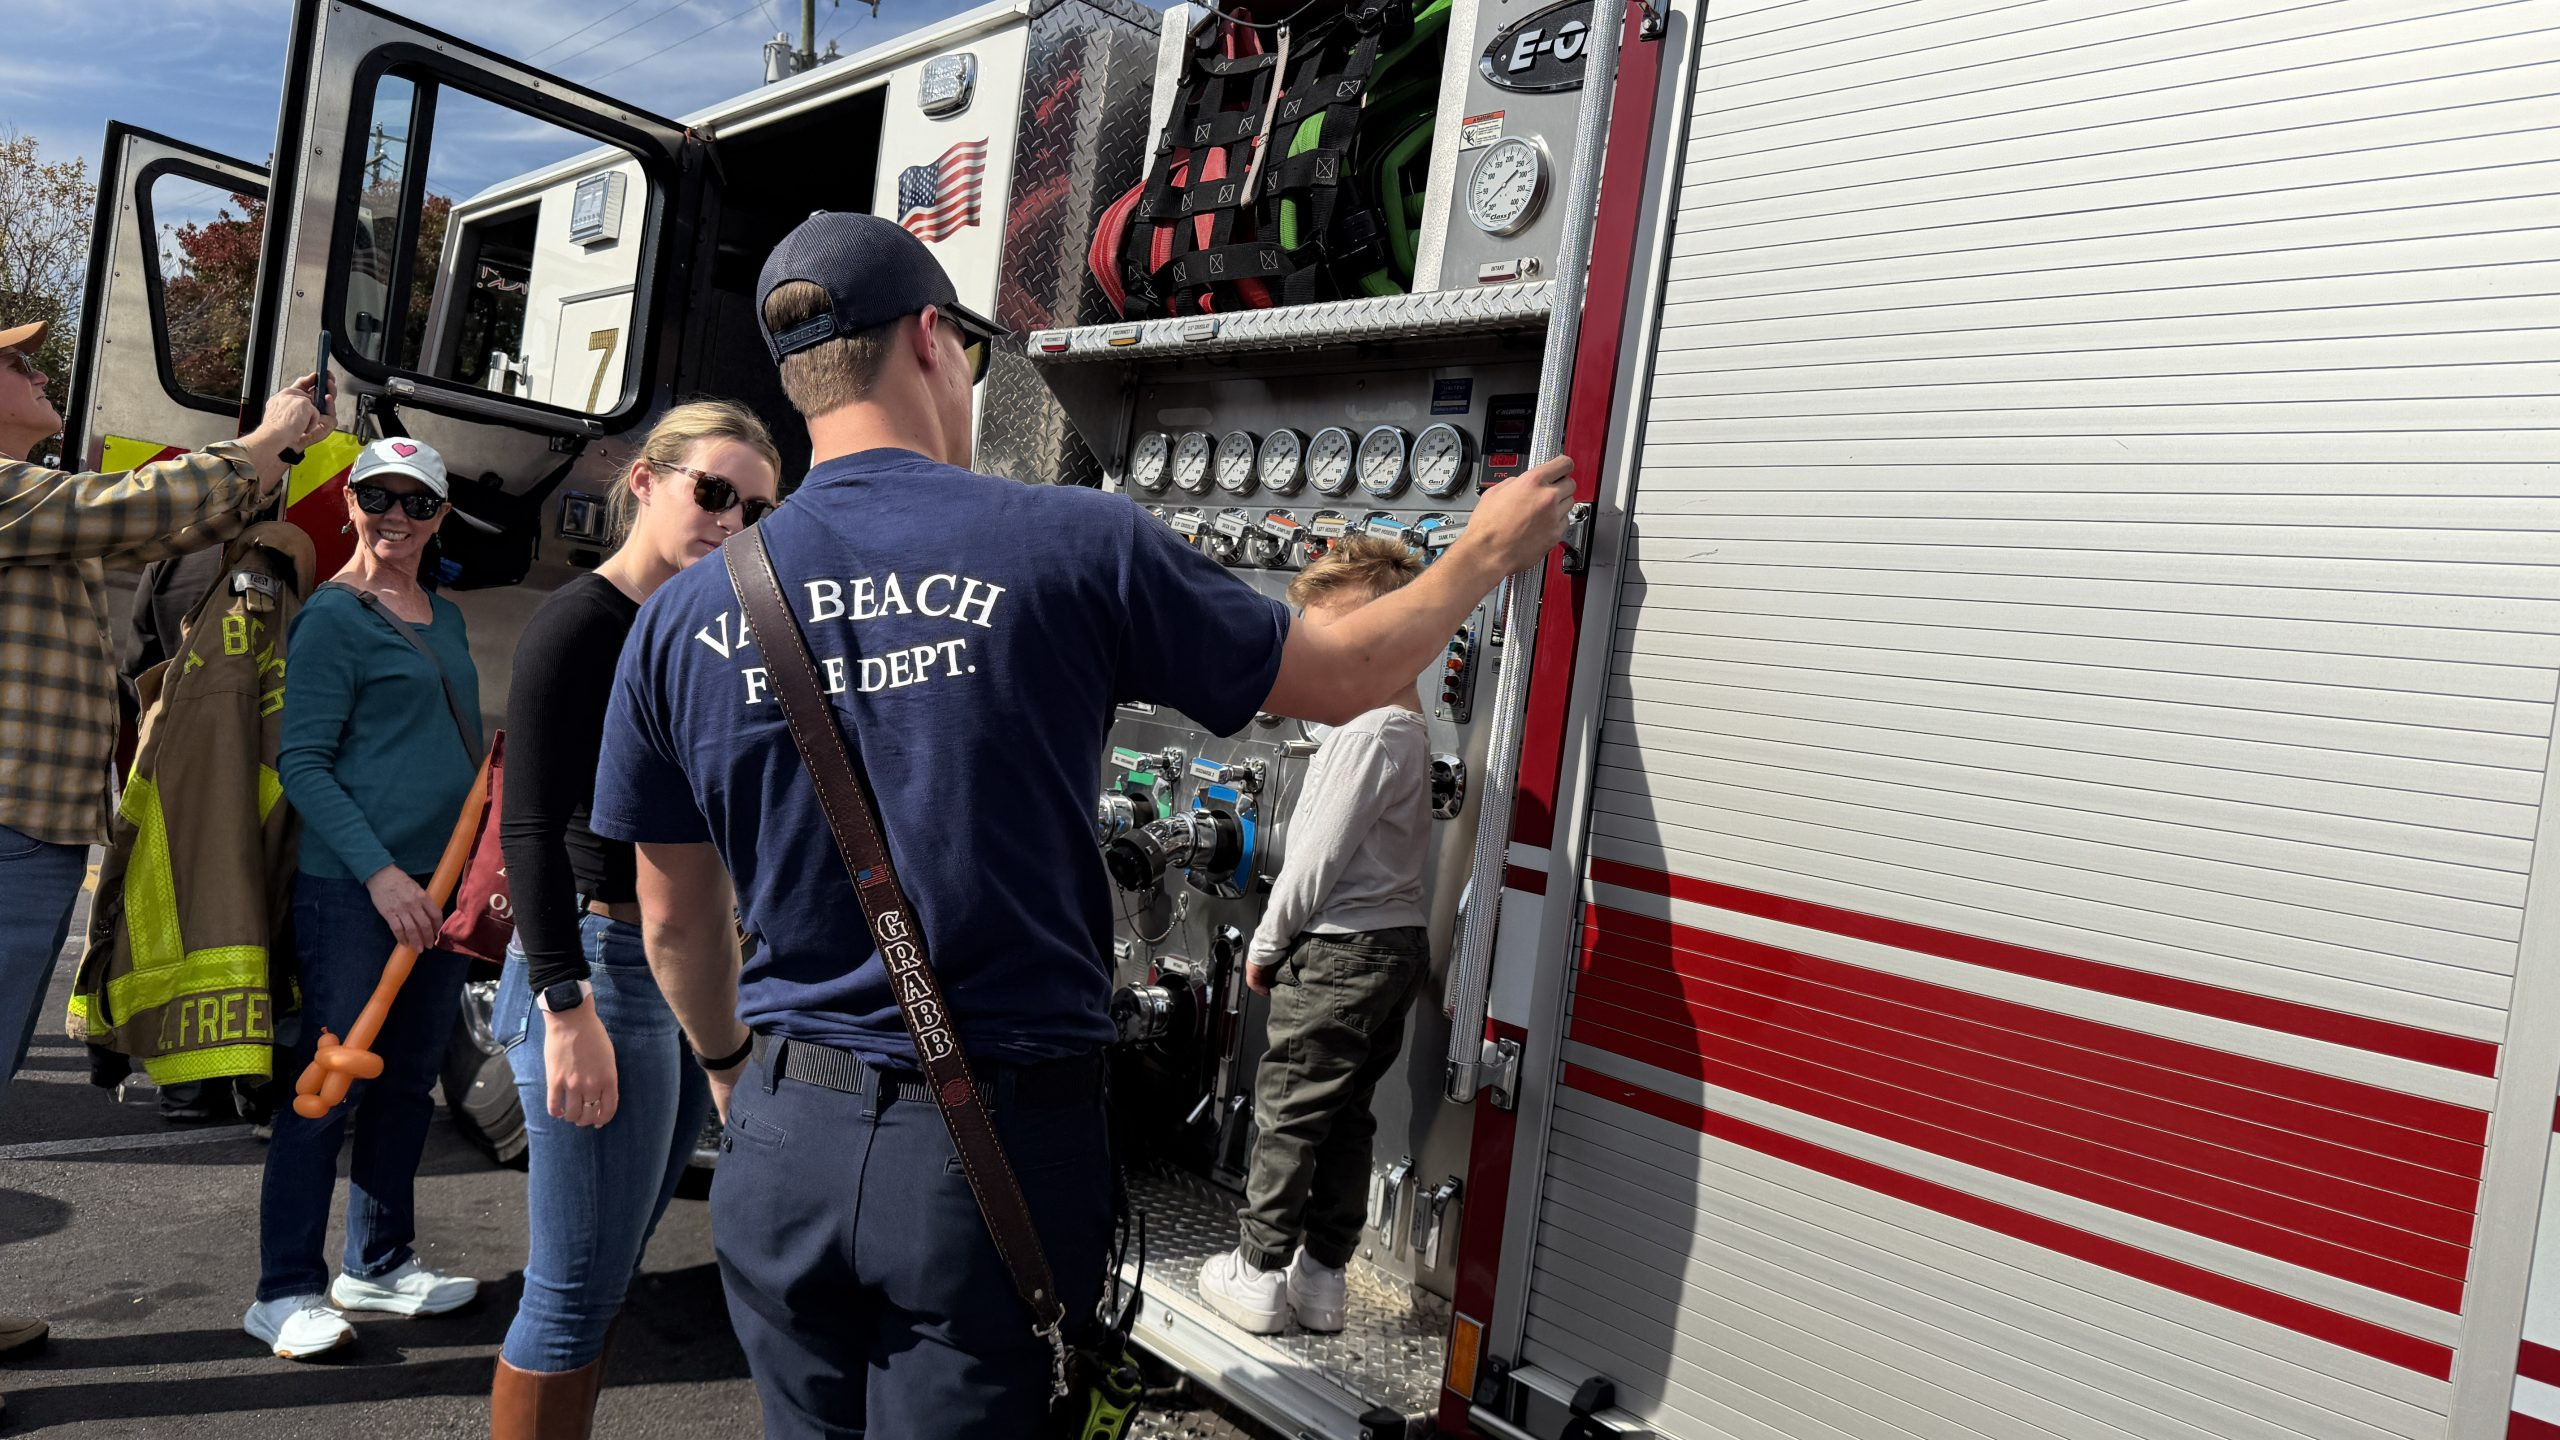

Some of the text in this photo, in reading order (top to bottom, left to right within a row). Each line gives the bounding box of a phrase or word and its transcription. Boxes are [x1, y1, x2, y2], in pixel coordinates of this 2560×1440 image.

[1508, 20, 1592, 71] E-O
[1505, 155, 1514, 163] 200
[1516, 160, 1525, 168] 250
[588, 328, 620, 415] 7
[804, 572, 1006, 628] BEACH
[741, 639, 976, 704] FE DEPT.
[877, 911, 953, 1062] GRABB
